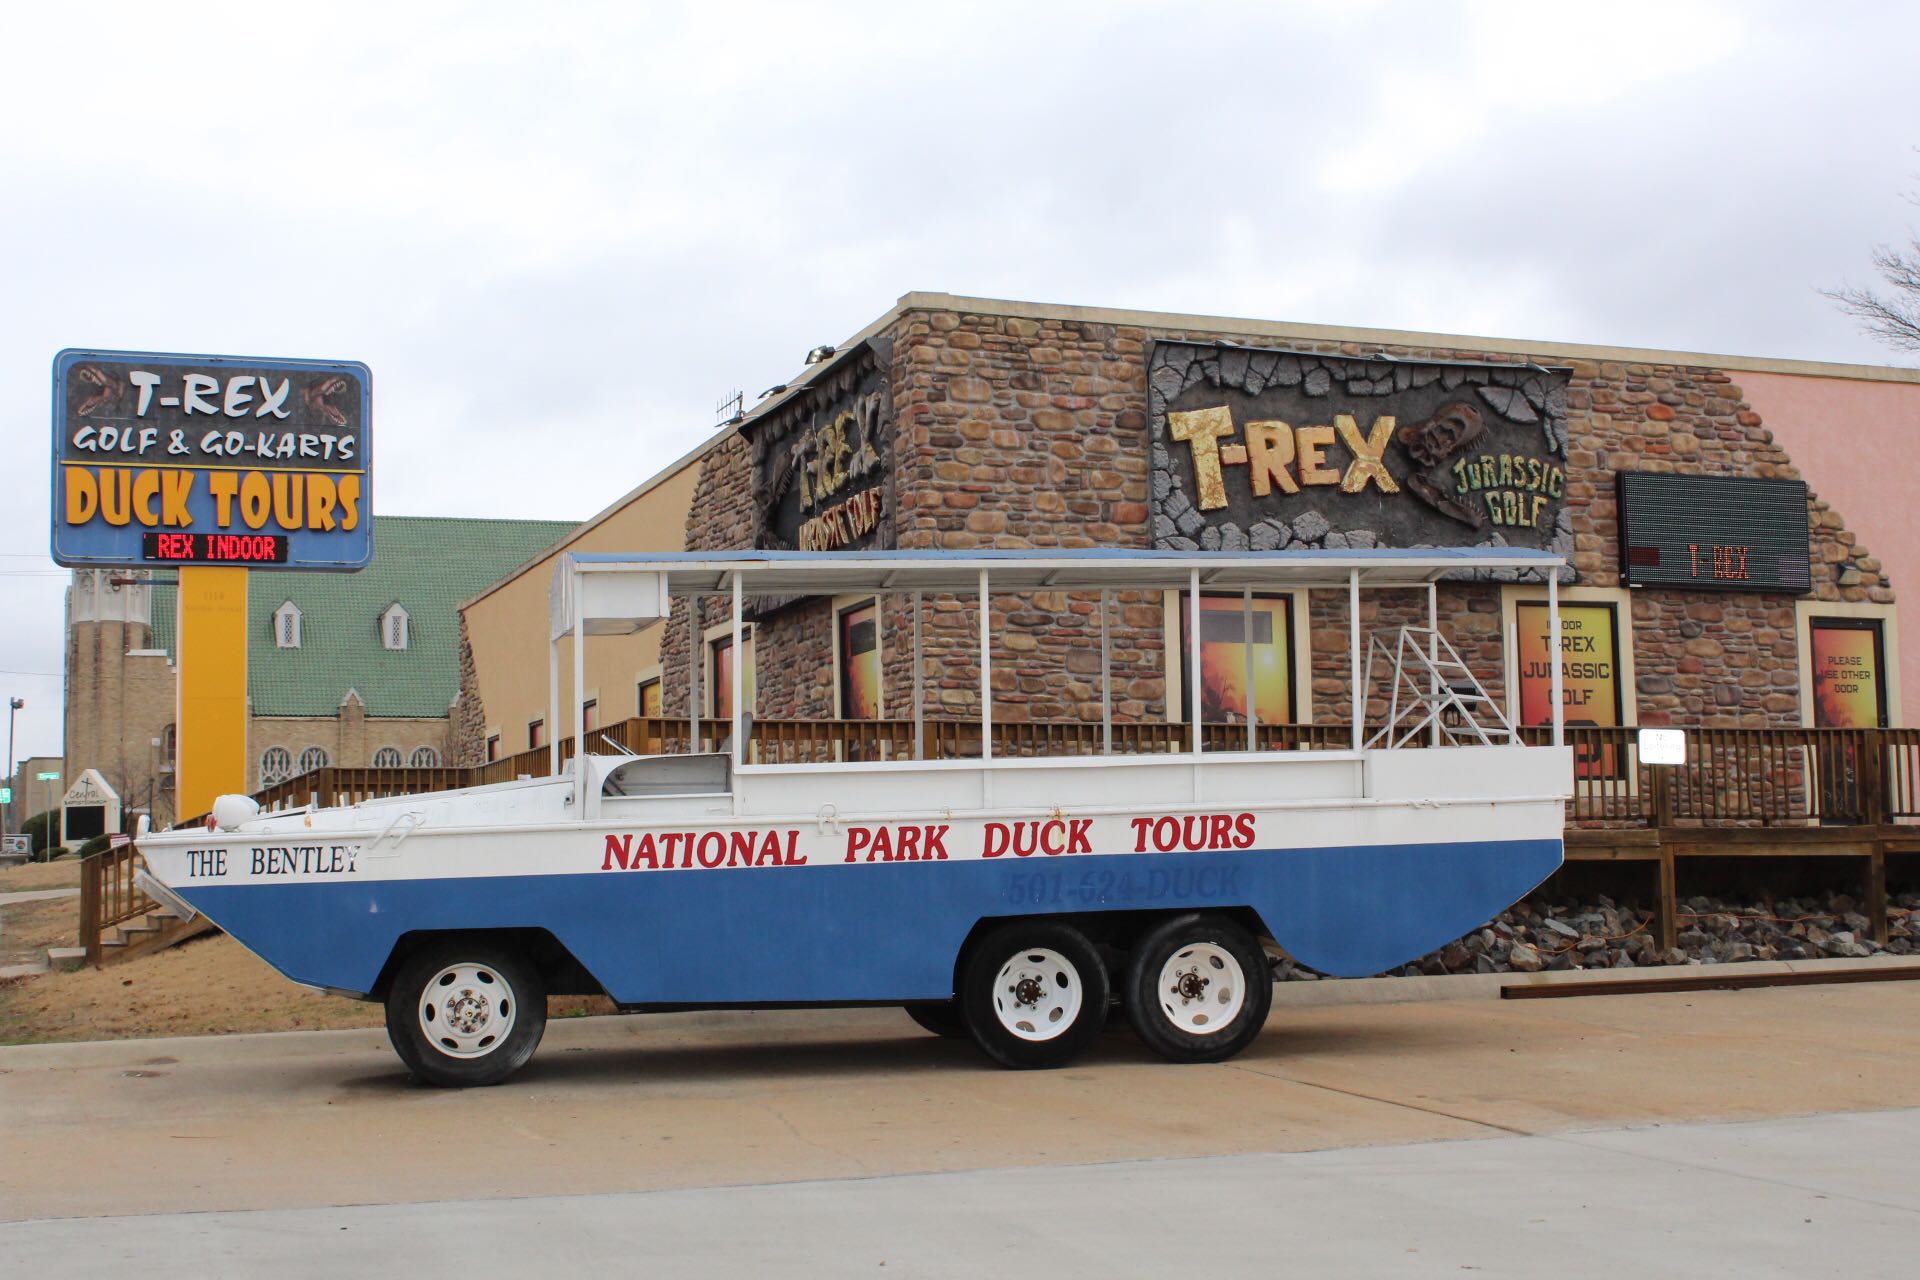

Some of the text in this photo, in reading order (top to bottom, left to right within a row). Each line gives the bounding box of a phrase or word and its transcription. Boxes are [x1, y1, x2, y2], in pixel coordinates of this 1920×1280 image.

[129, 370, 291, 419] T-REX
[72, 426, 355, 461] GOLF & GO-KARTS
[1167, 405, 1401, 512] T-REX
[1452, 454, 1564, 499] JURASSIC
[65, 466, 361, 532] DUCK TOURS
[1485, 490, 1549, 529] GOLF
[157, 534, 277, 561] REX INDOOR
[1546, 620, 1583, 630] IOOR
[1540, 635, 1596, 652] TREX
[1827, 656, 1863, 666] PLEASE
[1841, 670, 1871, 680] OTHER
[1834, 684, 1860, 694] DOOR
[601, 812, 1257, 872] NATIONAL PARK DUCK TOURS
[187, 846, 361, 877] THE BENTLEY
